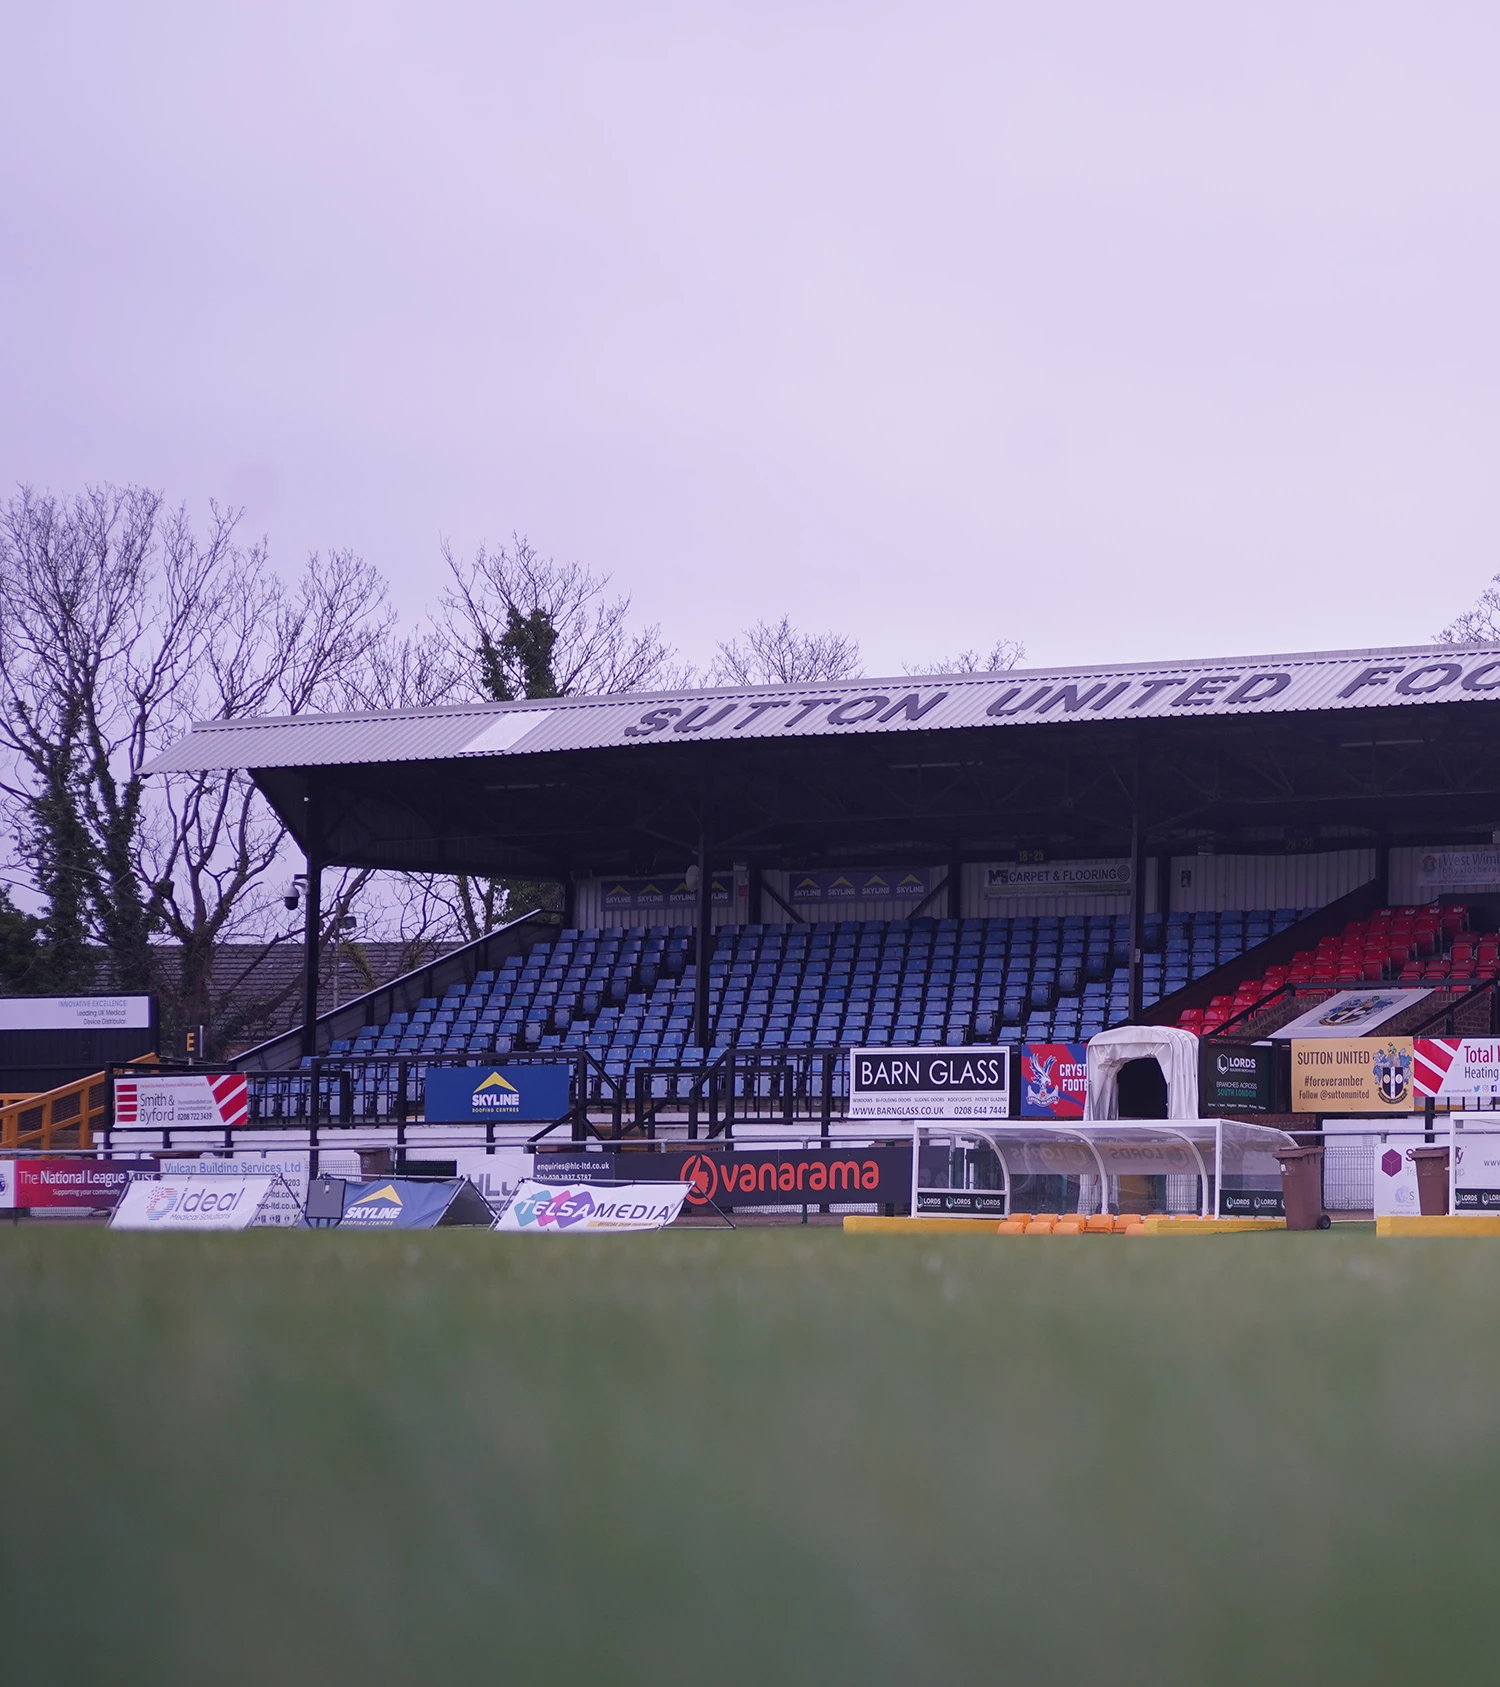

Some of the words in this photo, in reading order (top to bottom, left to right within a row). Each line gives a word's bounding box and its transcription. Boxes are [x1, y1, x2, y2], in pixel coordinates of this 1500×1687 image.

[624, 692, 948, 737] SUTTON
[985, 672, 1292, 716] UNITED
[1443, 853, 1470, 866] West
[1009, 871, 1050, 882] CARPET
[1053, 870, 1060, 880] &
[1063, 868, 1117, 880] FLOORING
[186, 1033, 195, 1051] E
[1297, 1051, 1333, 1065] SUTTON
[1336, 1050, 1370, 1064] UNITED
[1464, 1045, 1494, 1064] Total
[1229, 1057, 1256, 1069] LORDS
[861, 1060, 920, 1085] BARN
[929, 1059, 999, 1085] GLASS
[1464, 1066, 1499, 1081] Heating
[1062, 1079, 1088, 1092] FOOTB
[1304, 1075, 1363, 1087] #foreveramber
[140, 1093, 167, 1106] Smith
[169, 1095, 175, 1106] &
[472, 1094, 519, 1106] SKYLINE
[1299, 1090, 1318, 1099] Follow
[1320, 1089, 1370, 1100] @suttonunited
[140, 1108, 174, 1125] Byford
[852, 1106, 944, 1115] WWW.BARNGLASS.CO.UK
[954, 1106, 972, 1115] 0208
[974, 1106, 987, 1114] 644
[989, 1106, 1007, 1114] 7444
[164, 1163, 197, 1173] Vulcan
[200, 1162, 238, 1173] Building
[240, 1162, 282, 1174] Services
[284, 1162, 301, 1173] Ltd
[537, 1162, 609, 1171] enquiries@hlc-ltd.co.uk
[19, 1171, 39, 1184] The
[40, 1170, 85, 1184] National
[87, 1171, 125, 1187] League
[720, 1160, 879, 1193] vanarama
[52, 1189, 79, 1197] Supporting
[92, 1189, 120, 1197] community
[175, 1187, 245, 1212] ideal
[170, 1213, 200, 1221] Medical
[200, 1213, 231, 1221] Solutions
[344, 1207, 402, 1219] SKYLINE
